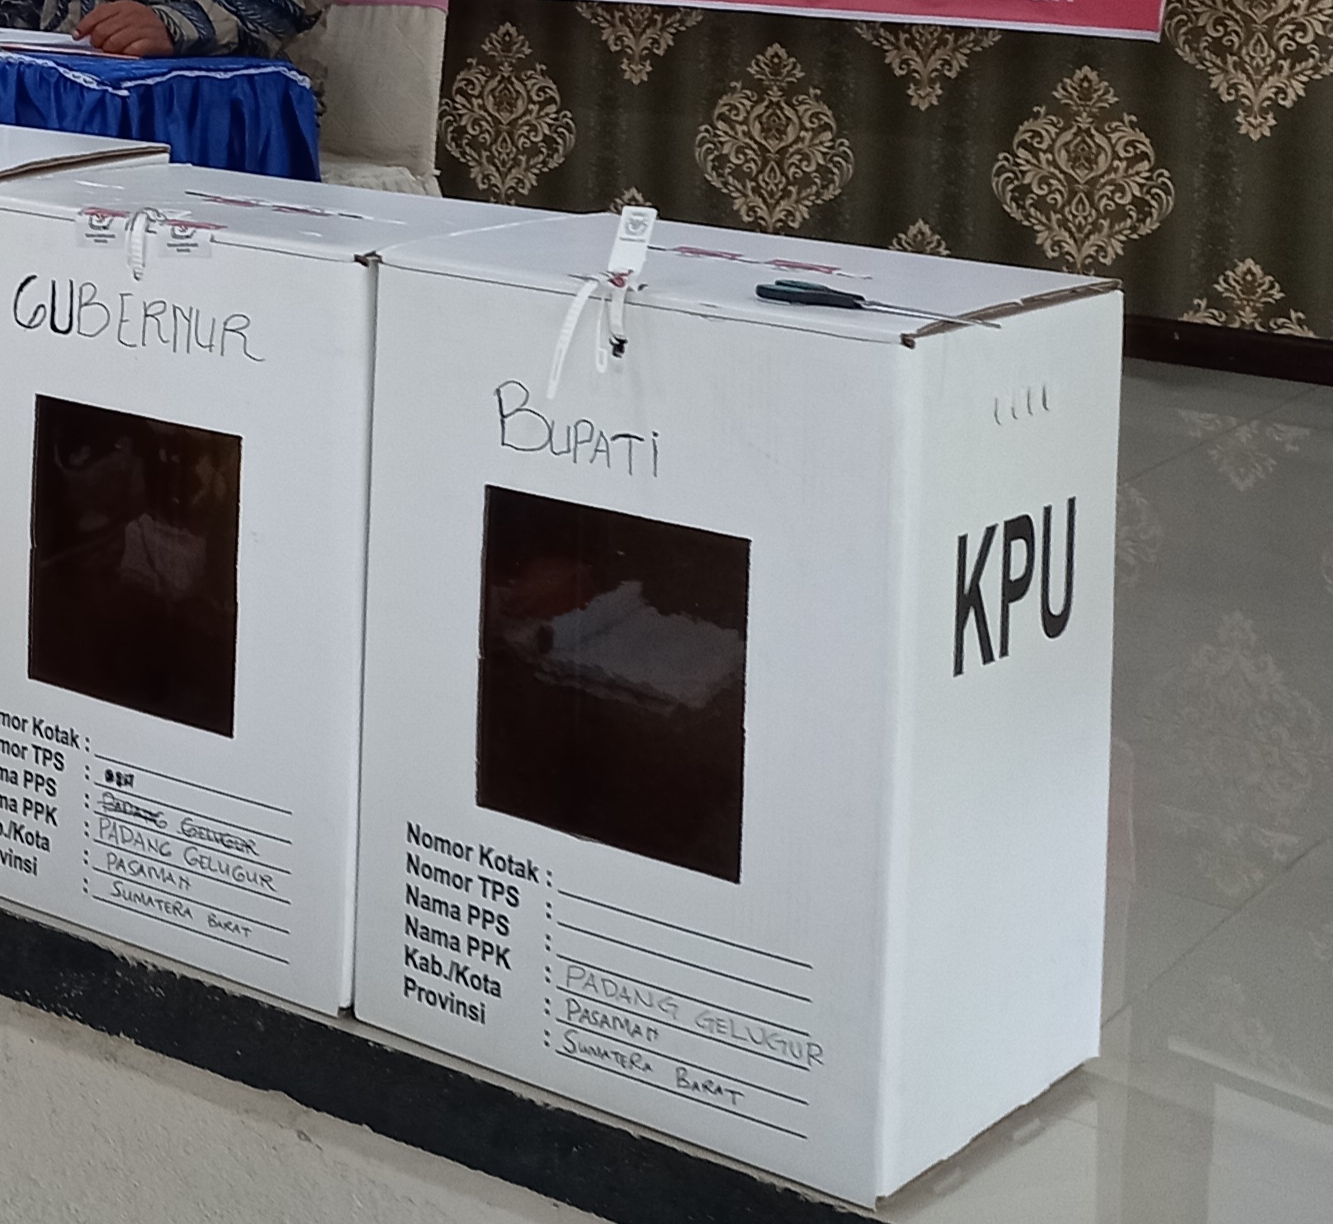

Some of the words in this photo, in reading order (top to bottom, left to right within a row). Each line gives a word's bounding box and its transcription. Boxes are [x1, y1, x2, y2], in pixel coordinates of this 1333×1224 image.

[12, 274, 266, 363] GUBERNUR
[953, 496, 1077, 677] KPU
[31, 743, 65, 772] TPS
[32, 716, 80, 750] Kotak
[23, 769, 58, 798] PPS
[22, 798, 59, 827] PPK
[406, 821, 474, 861] Nomor
[478, 842, 540, 885] Kotak
[405, 853, 473, 895] Nomor
[476, 877, 521, 908] TPS
[405, 885, 462, 923] Nama
[466, 904, 511, 938] PPS
[404, 915, 461, 954] Nama
[465, 936, 512, 971] PPK
[404, 947, 502, 1000] Kab./Kota
[403, 978, 487, 1026] Provinsi
[565, 963, 681, 1020] PADANG
[694, 1008, 825, 1067] GELUGUR
